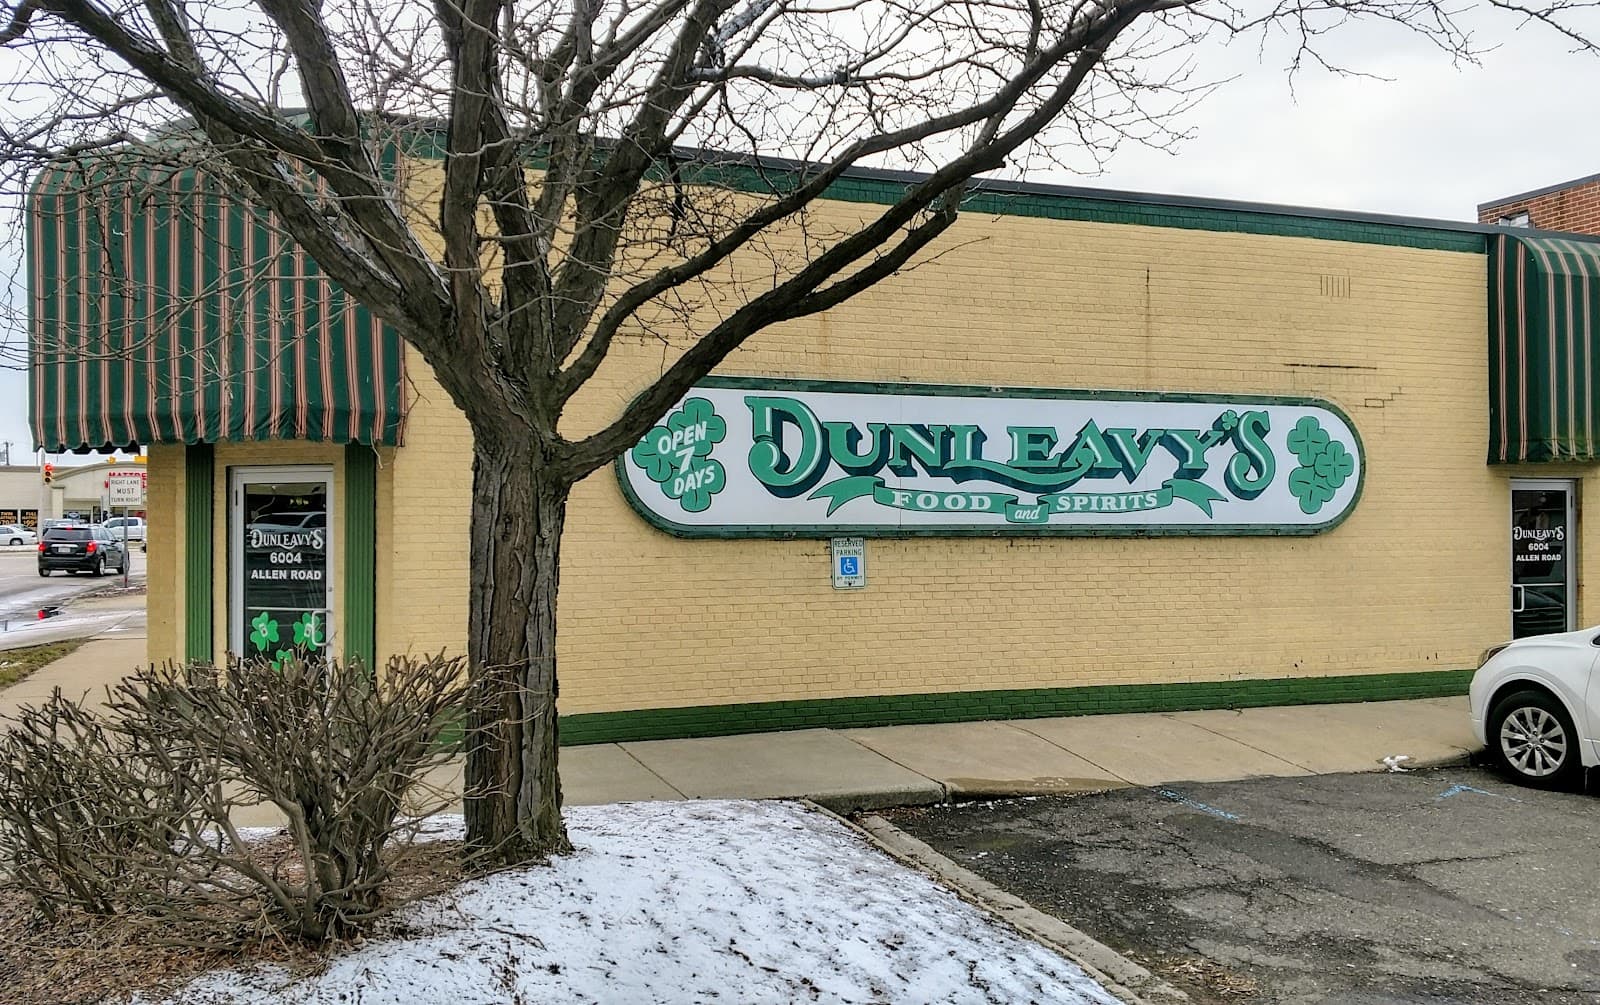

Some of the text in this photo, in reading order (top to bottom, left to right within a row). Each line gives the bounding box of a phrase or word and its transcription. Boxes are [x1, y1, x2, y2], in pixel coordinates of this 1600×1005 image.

[657, 421, 708, 455] OPEN
[744, 396, 1275, 499] DUNLEAVY'S
[675, 446, 696, 475] 7
[673, 465, 716, 495] DAYS
[116, 487, 135, 495] MUST
[891, 490, 1159, 520] FOOD and SPIRITS
[250, 529, 323, 549] DUNLEAVY'S
[1513, 526, 1564, 540] DUNLEAVY'S
[1528, 543, 1549, 551] 6004
[270, 552, 302, 564] 6004
[1515, 554, 1540, 562] ALLEN
[251, 569, 322, 580] ALLEN ROAD
